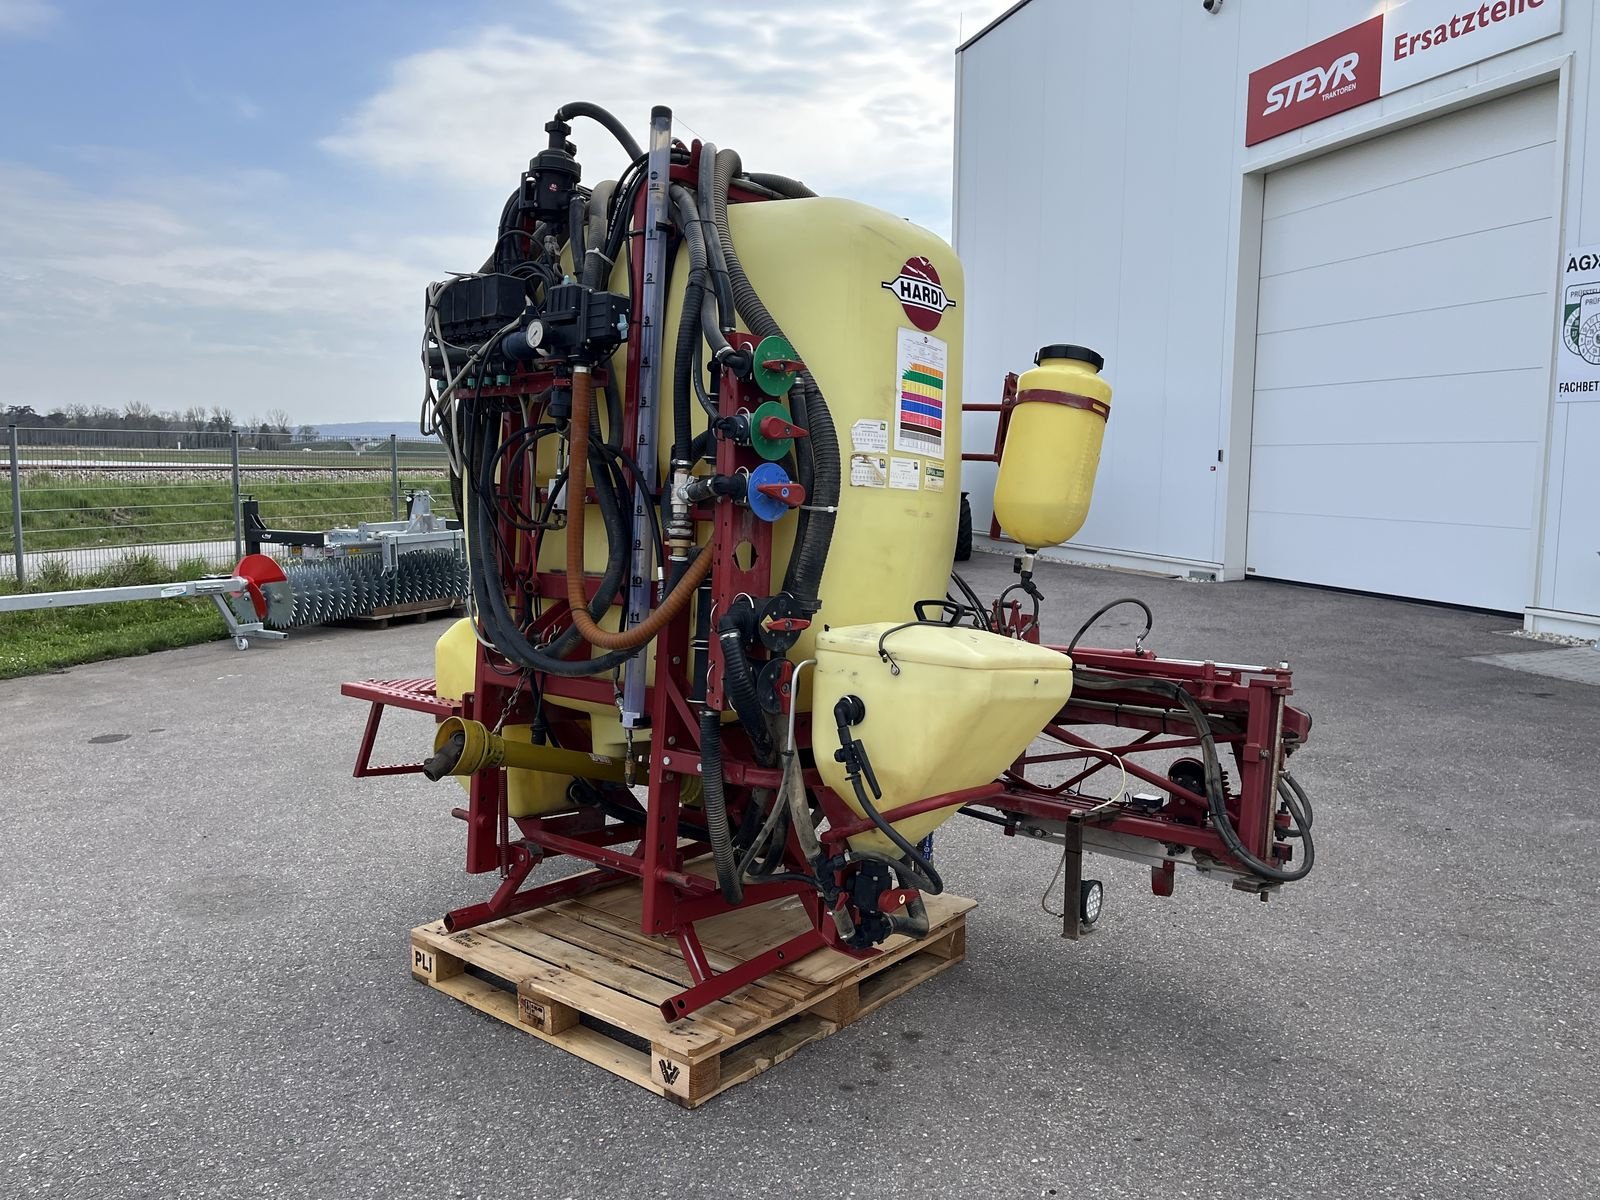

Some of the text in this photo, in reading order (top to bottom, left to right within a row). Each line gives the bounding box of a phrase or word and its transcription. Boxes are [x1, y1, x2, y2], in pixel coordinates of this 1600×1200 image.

[1262, 52, 1359, 116] STEYR
[1322, 82, 1357, 101] TRAKTOREN
[646, 272, 653, 281] 2
[900, 280, 942, 308] HARDI
[644, 316, 650, 325] 3
[642, 357, 648, 365] 4
[641, 396, 647, 406] 5
[639, 434, 645, 444] 6
[636, 504, 643, 514] 8
[635, 540, 641, 549] 9
[631, 575, 642, 585] 10
[630, 612, 640, 621] 11
